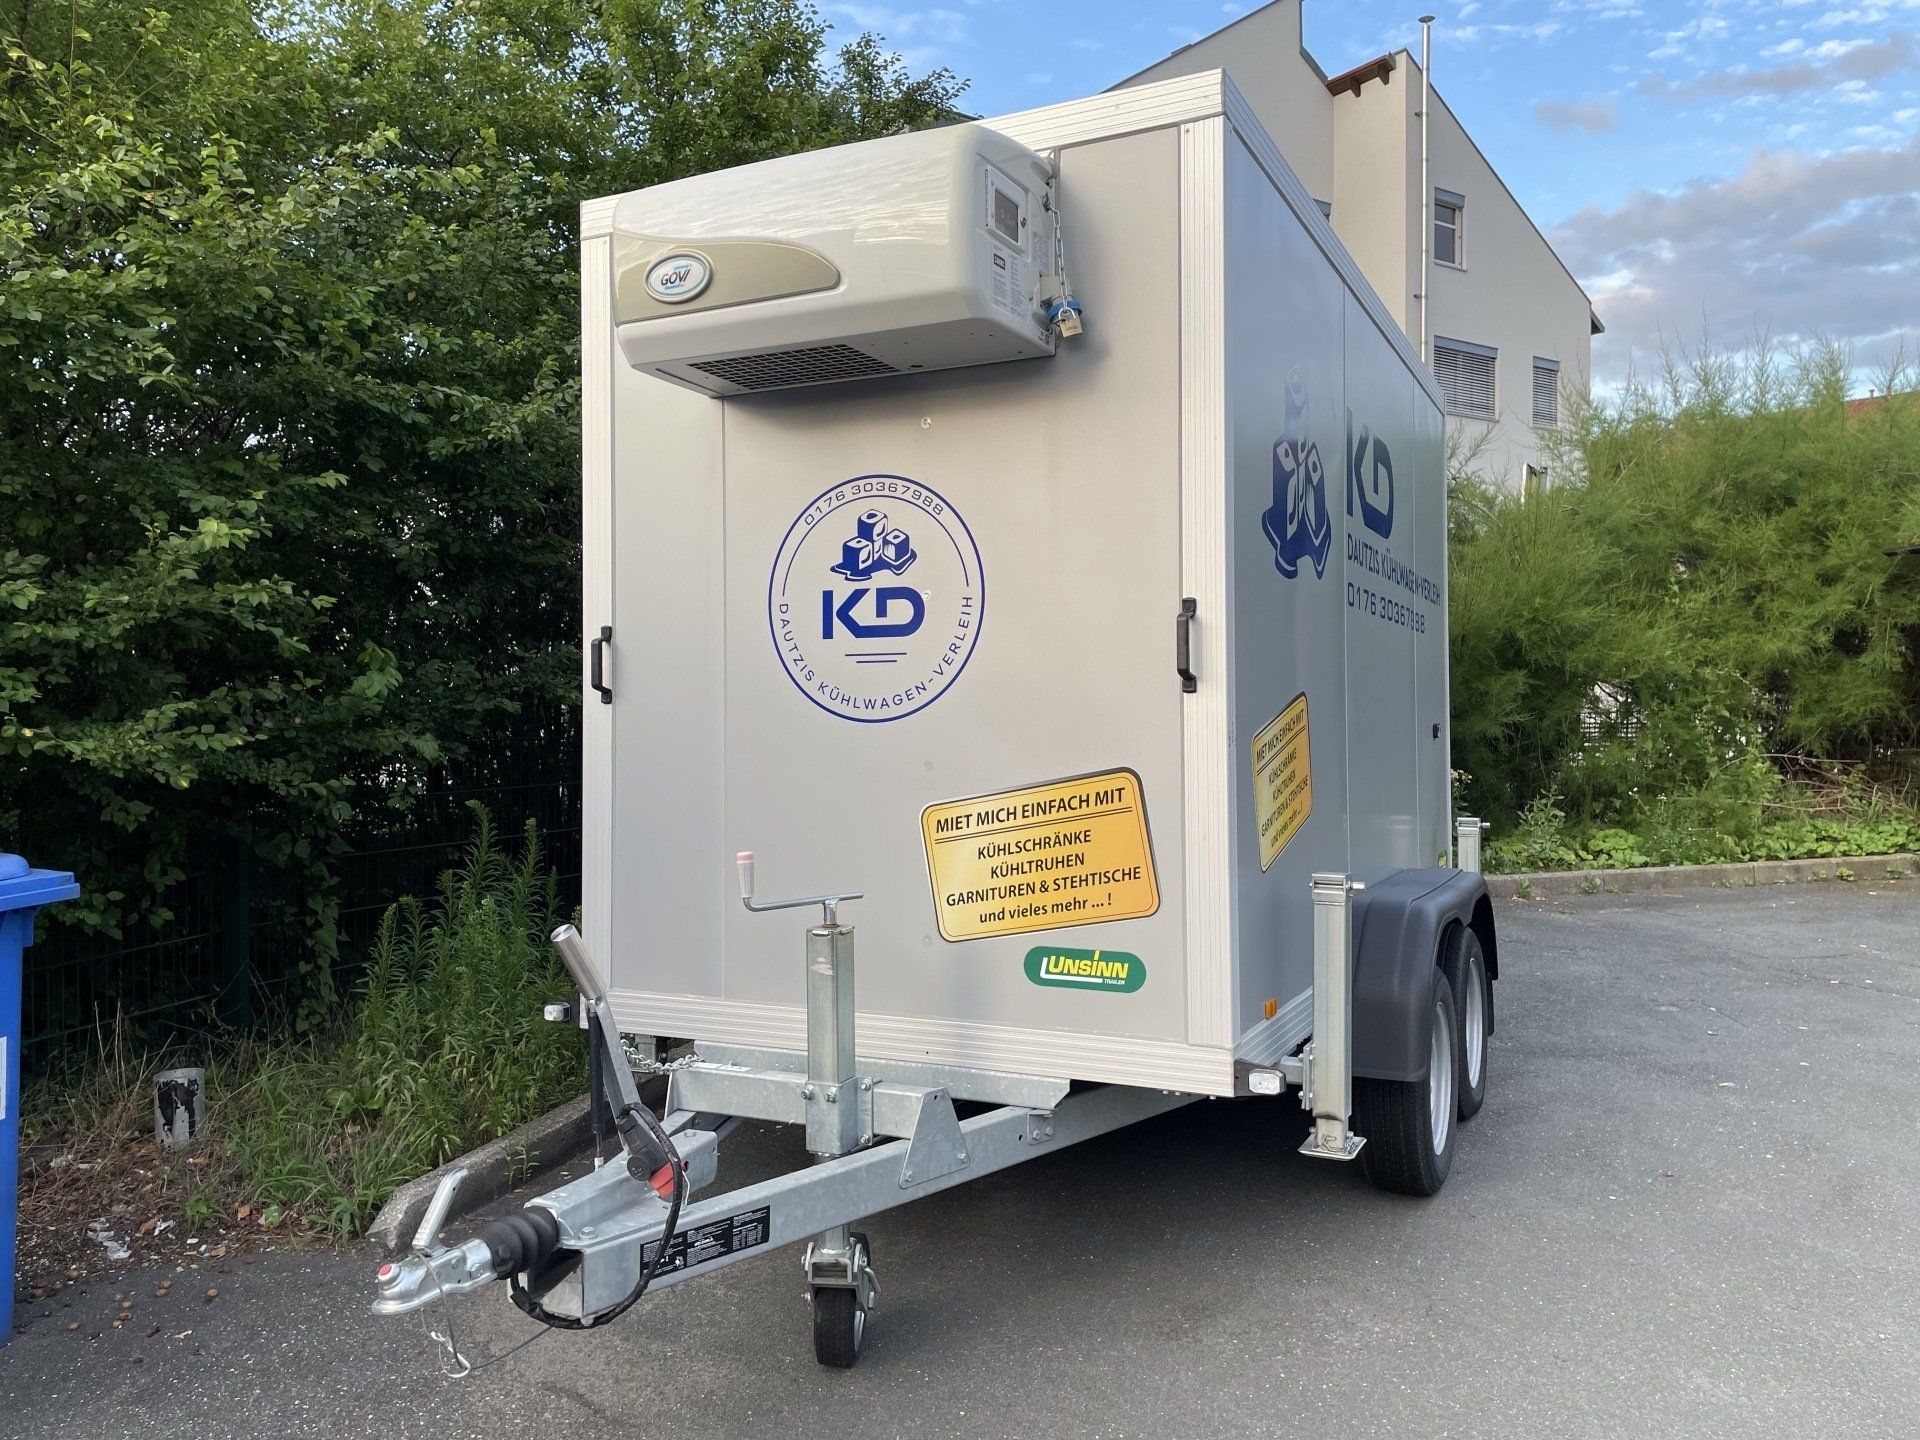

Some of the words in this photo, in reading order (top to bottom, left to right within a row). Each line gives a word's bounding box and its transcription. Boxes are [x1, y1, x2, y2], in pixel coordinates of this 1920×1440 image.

[661, 268, 691, 286] GOVI
[804, 490, 846, 526] 0176
[851, 481, 944, 516] 30367988
[1347, 532, 1380, 575] DAUTZIS
[822, 586, 926, 640] KD
[1347, 582, 1377, 616] 0176
[1380, 596, 1425, 634] 30367988
[779, 602, 815, 682] DAUTZIS
[936, 814, 973, 834] MIET
[976, 806, 1018, 827] MICH
[1021, 793, 1090, 819] EINFACH
[1094, 787, 1126, 807] MIT
[977, 829, 1092, 860] KÜHLSCHRÄNKE
[990, 852, 1085, 880] KÜHLTRUHEN
[946, 881, 1036, 907] GARNITUREN
[1039, 880, 1050, 893] &
[1052, 866, 1142, 892] STEHTISCHE
[979, 907, 1005, 924] und
[1008, 902, 1048, 921] vieles
[1051, 897, 1088, 914] mehr
